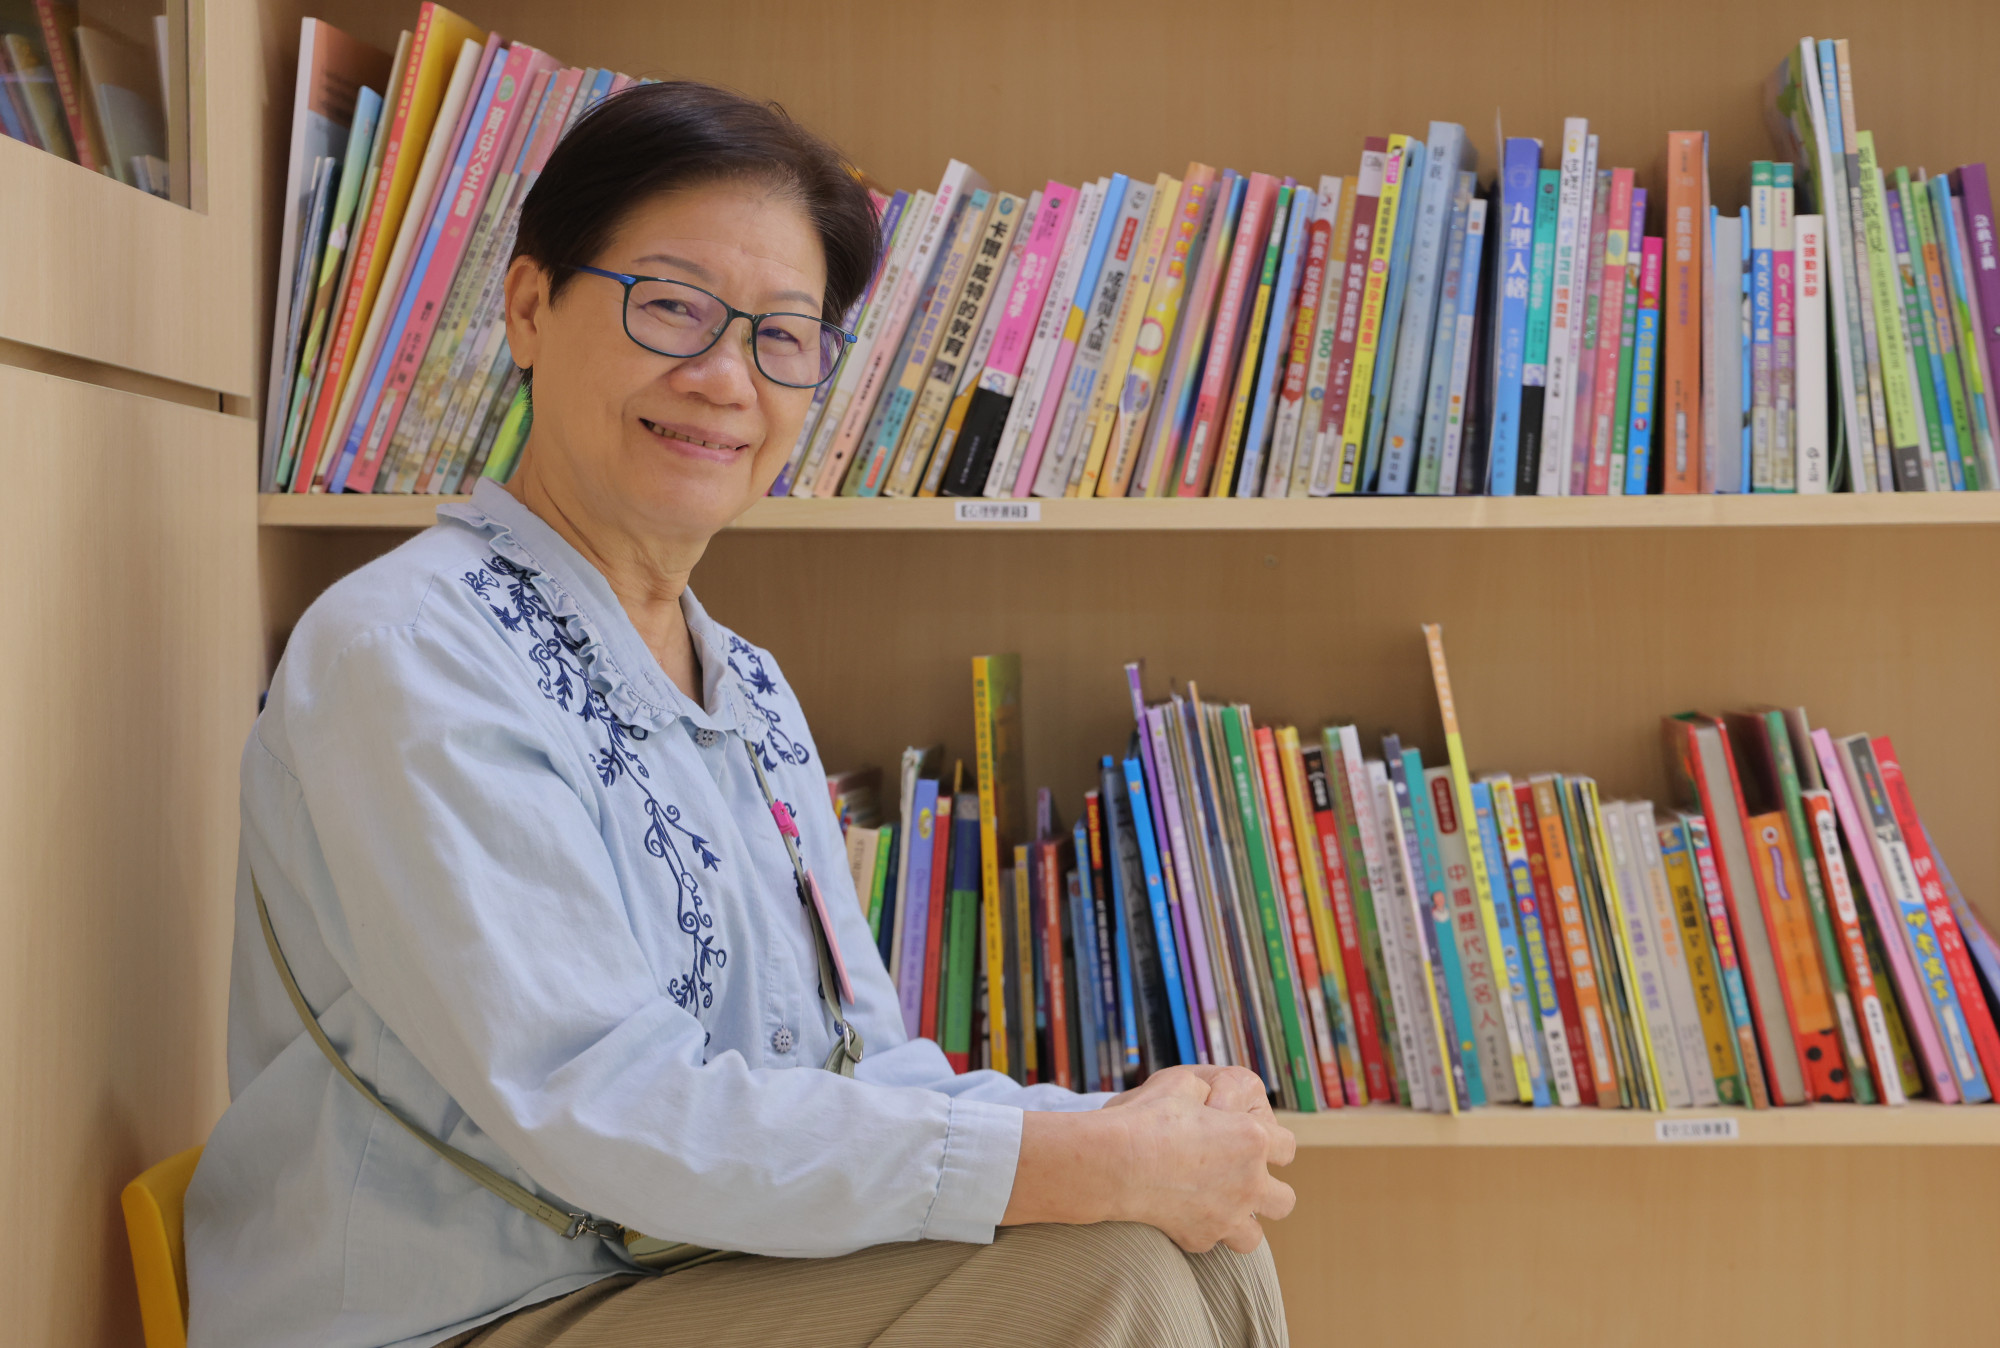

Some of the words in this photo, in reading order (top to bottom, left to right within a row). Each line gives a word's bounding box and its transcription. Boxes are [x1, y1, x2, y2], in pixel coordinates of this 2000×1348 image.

[1505, 202, 1532, 300] 九型人格
[1447, 862, 1499, 1031] 中國歷代女名人
[1557, 884, 1595, 991] 安徒生童話
